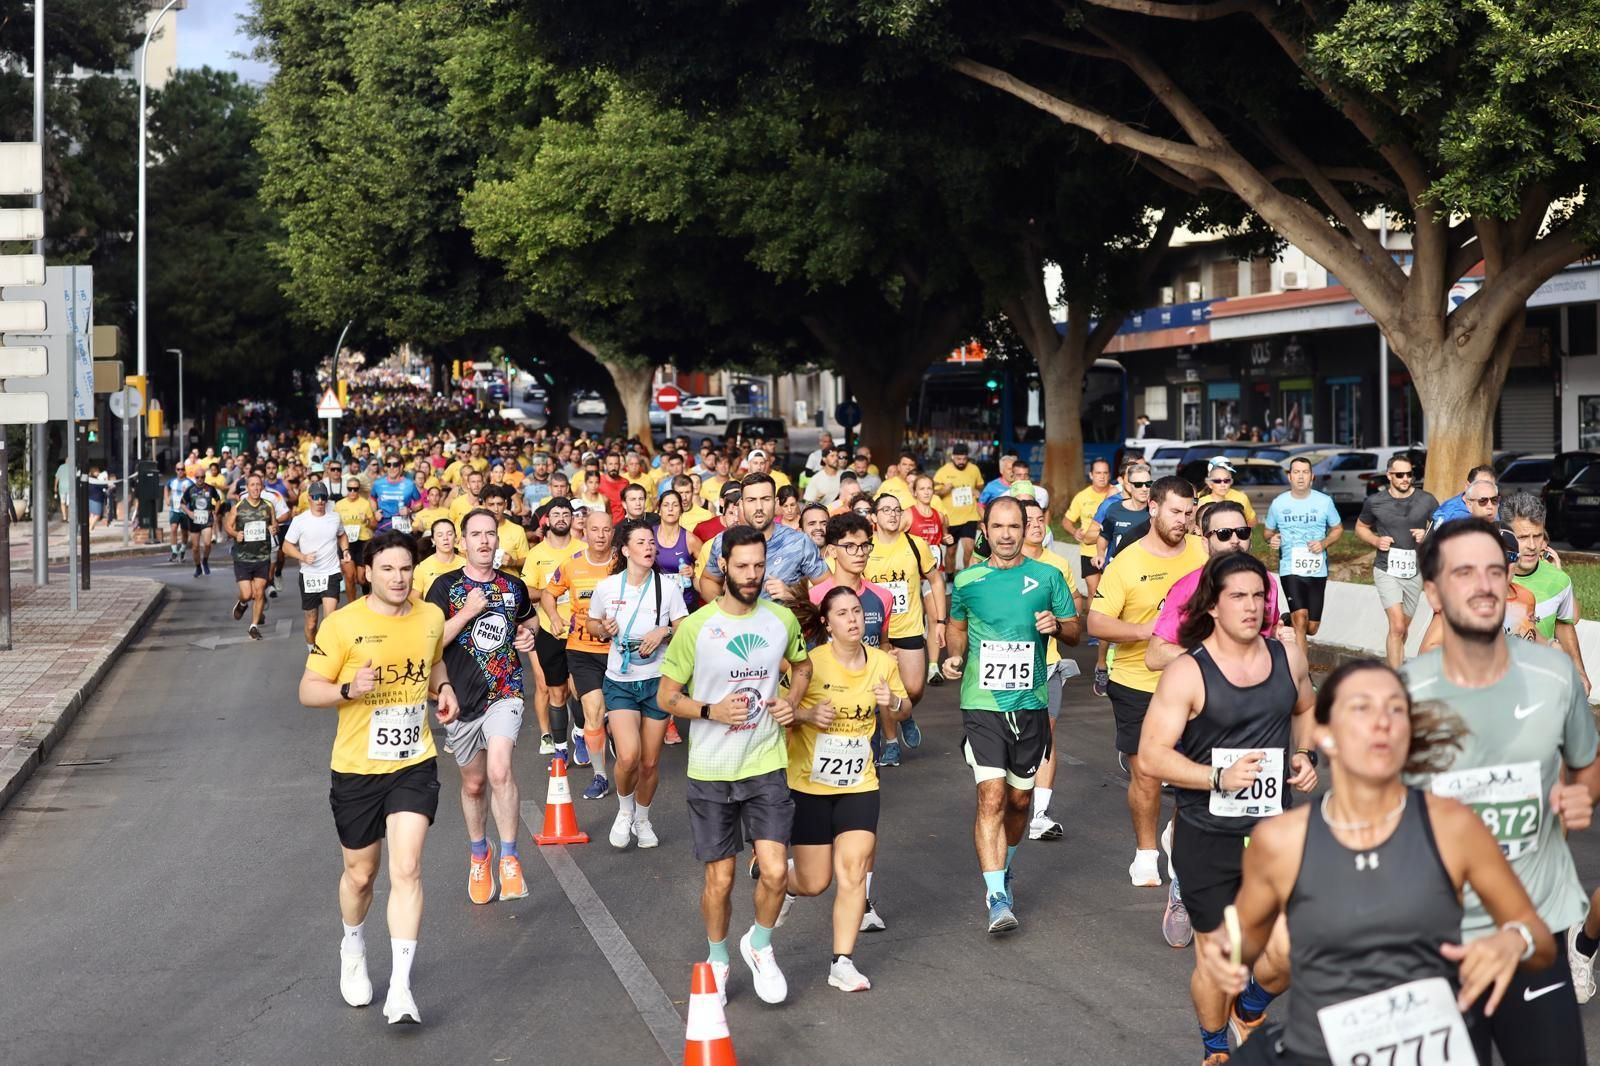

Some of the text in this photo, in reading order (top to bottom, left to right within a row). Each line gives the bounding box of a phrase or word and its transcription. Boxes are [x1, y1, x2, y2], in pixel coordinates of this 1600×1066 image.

[1284, 512, 1317, 524] nerja
[1295, 559, 1321, 568] 5675
[1390, 560, 1416, 570] 11312
[306, 578, 327, 588] 6314
[892, 594, 906, 606] 13
[730, 666, 768, 679] Unicaja
[984, 663, 1030, 680] 2715
[364, 690, 403, 699] CARRERA
[364, 698, 403, 706] URBANA
[376, 726, 420, 746] 5338
[819, 757, 864, 775] 7213
[1234, 777, 1277, 800] 208
[1481, 805, 1538, 836] 872
